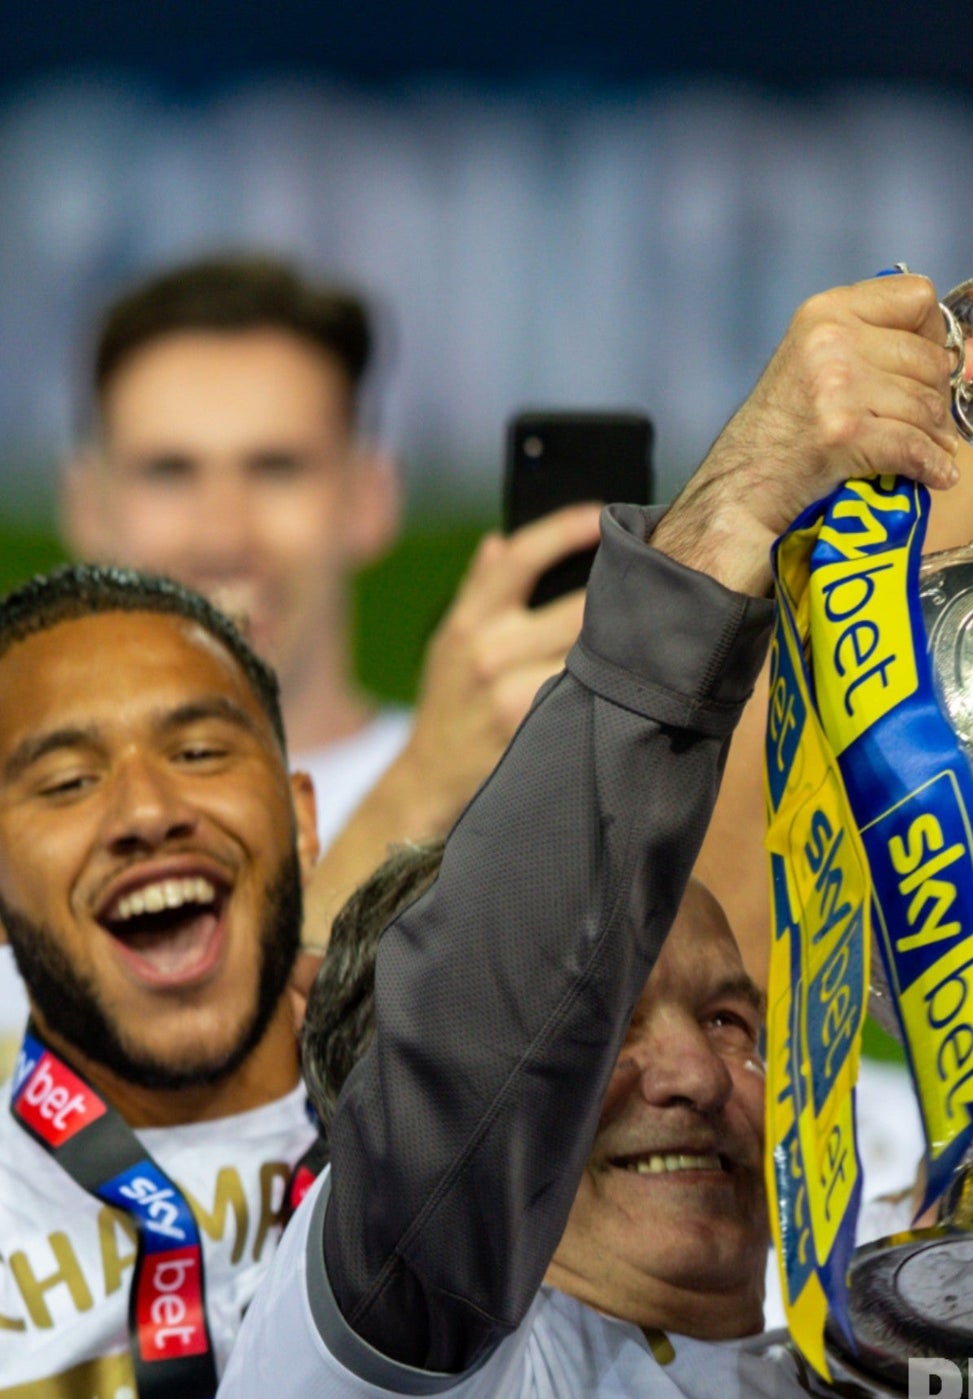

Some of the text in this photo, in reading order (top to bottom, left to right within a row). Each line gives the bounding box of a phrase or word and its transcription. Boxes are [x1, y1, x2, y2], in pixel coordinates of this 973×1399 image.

[821, 563, 898, 717] bet
[804, 809, 858, 1078] sky bet
[888, 813, 966, 953] sky
[25, 1062, 87, 1130] bet
[119, 1176, 196, 1350] sky bet
